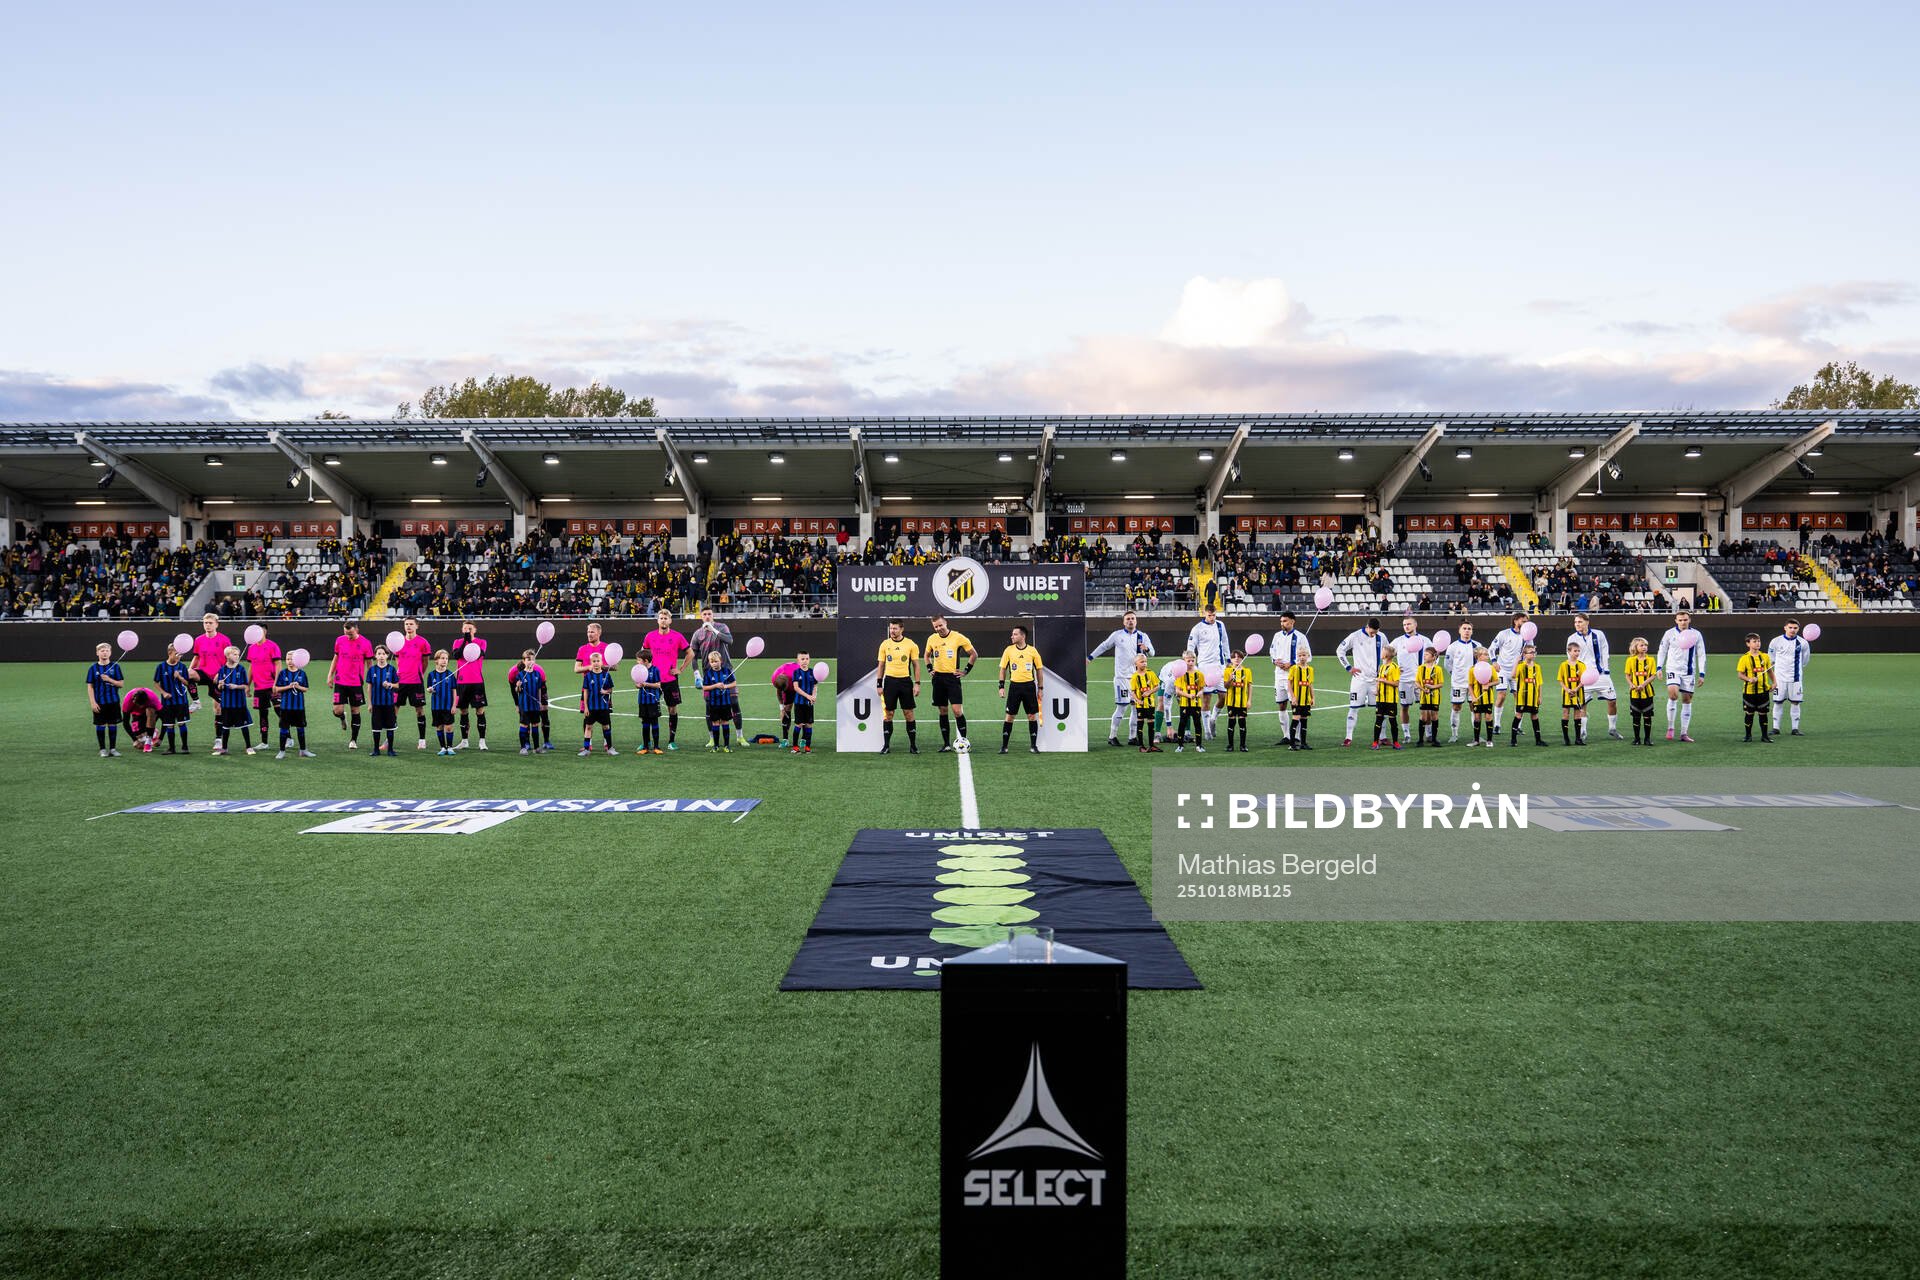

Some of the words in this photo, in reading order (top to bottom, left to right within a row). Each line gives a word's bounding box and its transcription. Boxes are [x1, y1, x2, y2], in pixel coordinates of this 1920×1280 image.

[1074, 520, 1116, 528] BRA
[1129, 520, 1171, 528] BRA
[1241, 519, 1283, 527] BRA
[1296, 519, 1338, 527] BRA
[1410, 519, 1452, 527] BRA
[1578, 518, 1620, 526] BRA
[1633, 517, 1675, 525] BRA
[1746, 516, 1788, 525] BRA
[239, 525, 281, 533] BRA
[572, 523, 613, 531] BRA
[626, 523, 668, 531] BRA
[739, 522, 780, 530] BRA
[793, 522, 836, 530] BRA
[906, 521, 948, 529] BRA
[73, 526, 114, 534] BRA
[851, 577, 918, 592] UNIBET
[1003, 575, 1071, 591] UNIBET
[853, 698, 871, 721] U
[1052, 698, 1070, 721] U
[227, 799, 737, 812] ALLSVENSKAN
[963, 1169, 1106, 1206] SELECT
